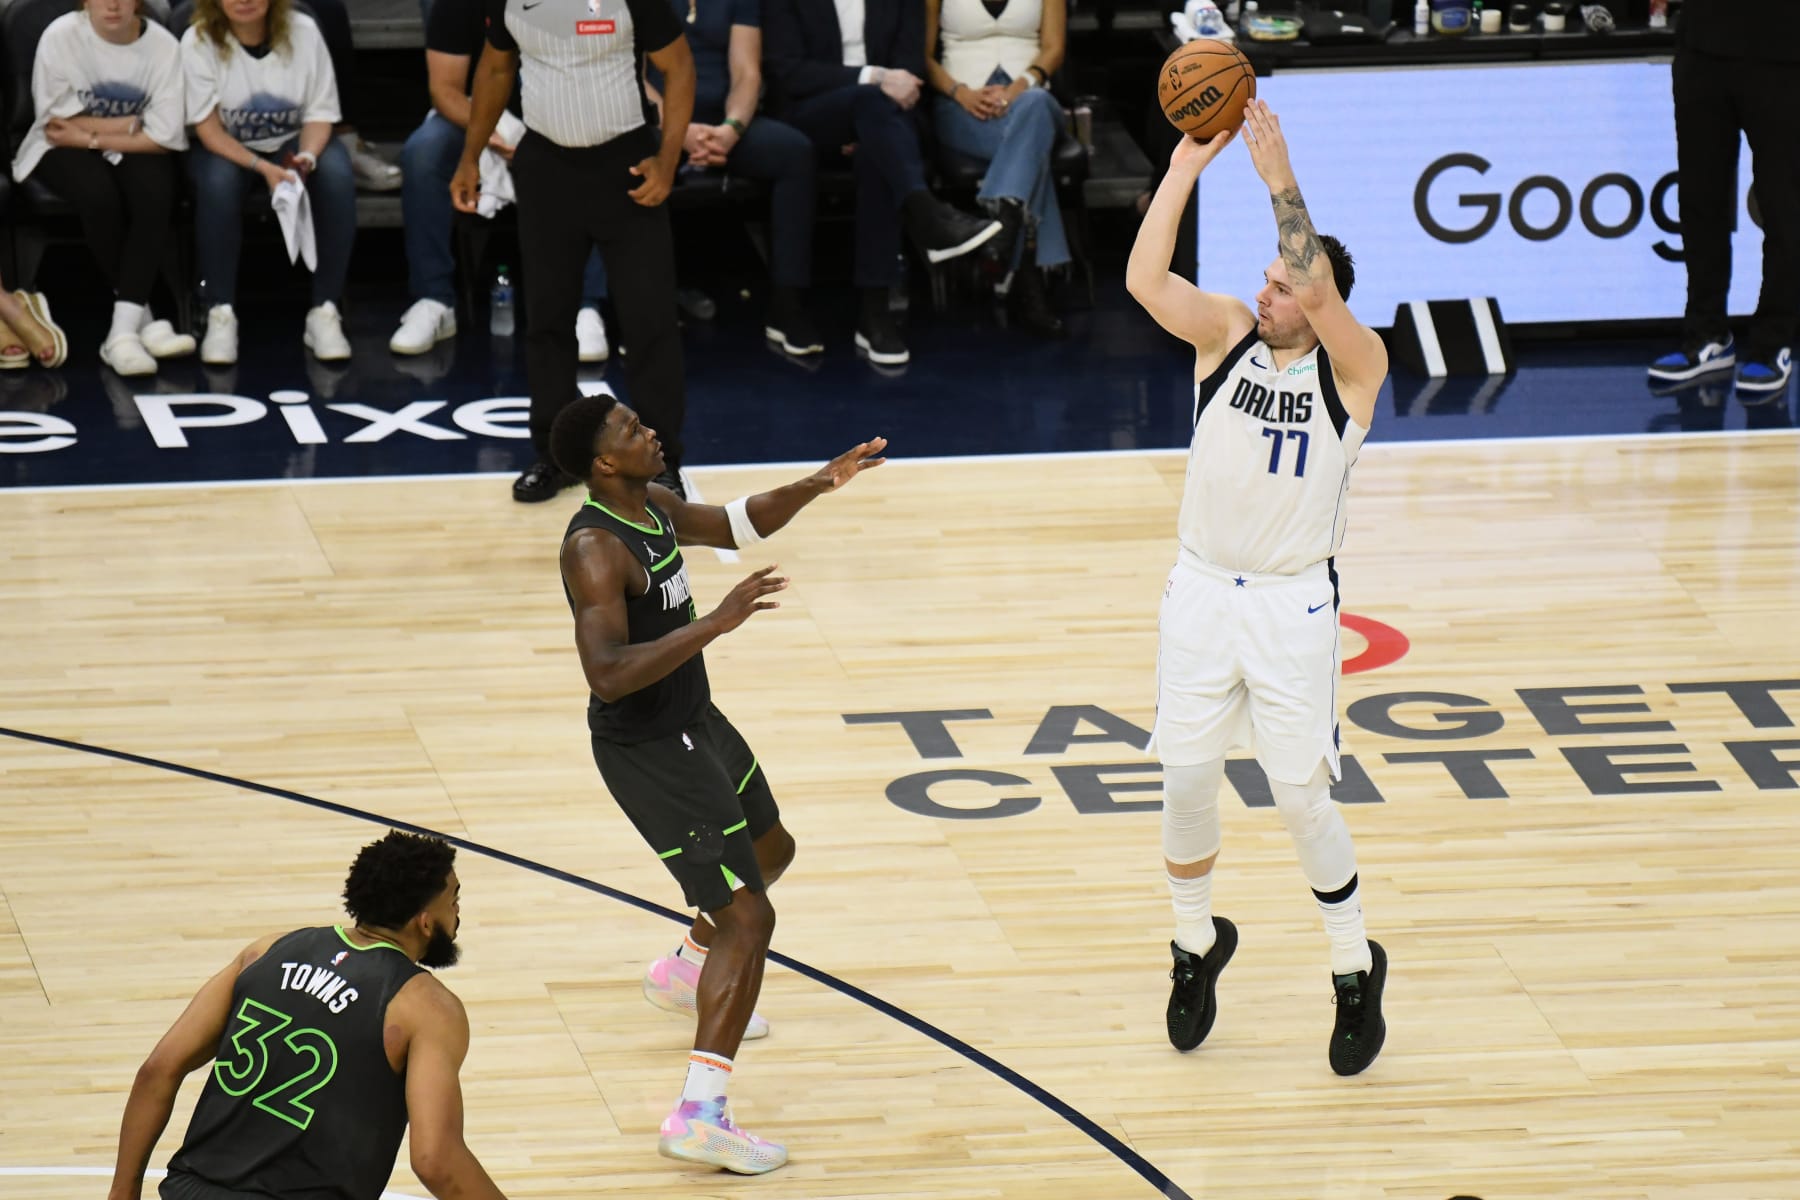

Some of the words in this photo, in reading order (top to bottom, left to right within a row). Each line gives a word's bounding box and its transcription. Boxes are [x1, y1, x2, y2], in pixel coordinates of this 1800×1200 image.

[1168, 86, 1224, 122] Wilson
[1413, 152, 1763, 263] Goog
[1287, 364, 1316, 376] chime
[133, 382, 617, 448] Pixe
[1262, 427, 1309, 478] 77
[841, 679, 1800, 760] TAGET
[280, 962, 359, 1014] TOWNS
[214, 998, 338, 1130] 32
